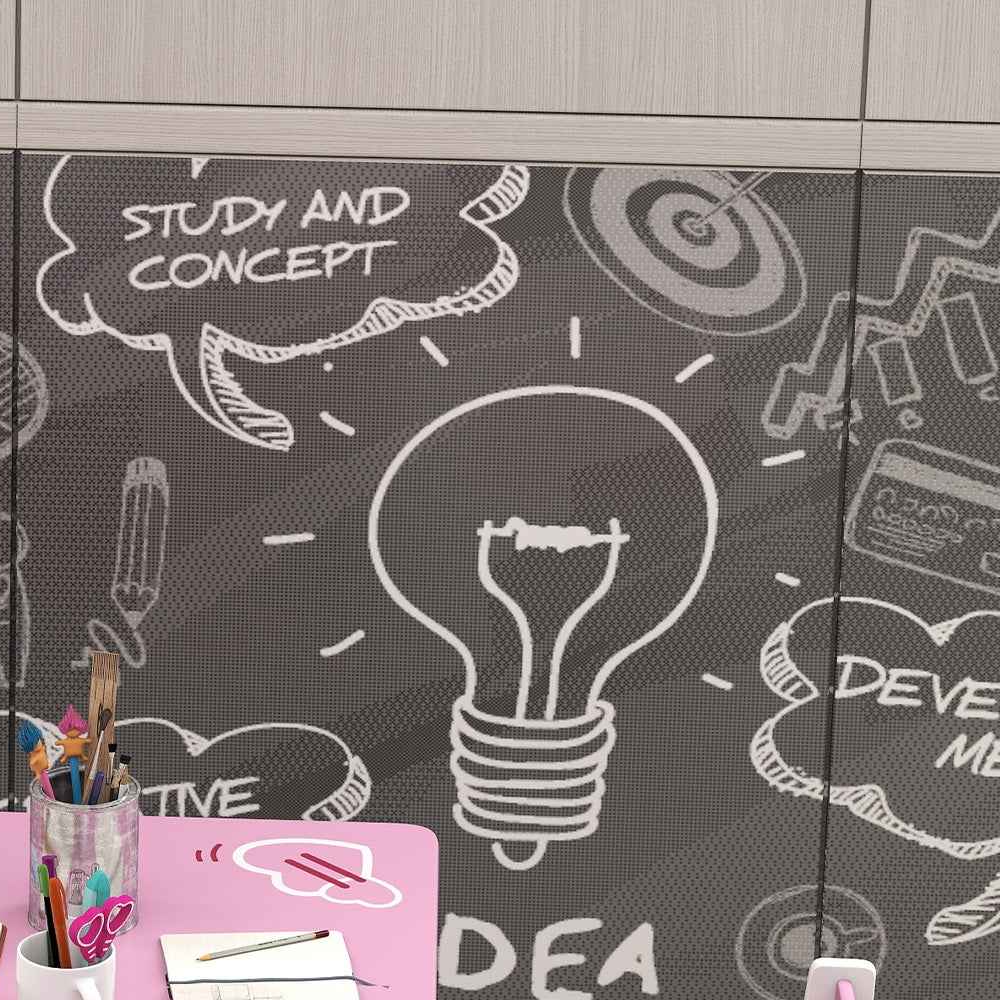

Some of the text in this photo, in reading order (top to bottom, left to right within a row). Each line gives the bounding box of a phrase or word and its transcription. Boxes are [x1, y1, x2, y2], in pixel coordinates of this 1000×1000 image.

[121, 186, 411, 241] STUDY AND
[127, 239, 399, 292] CONCEPT
